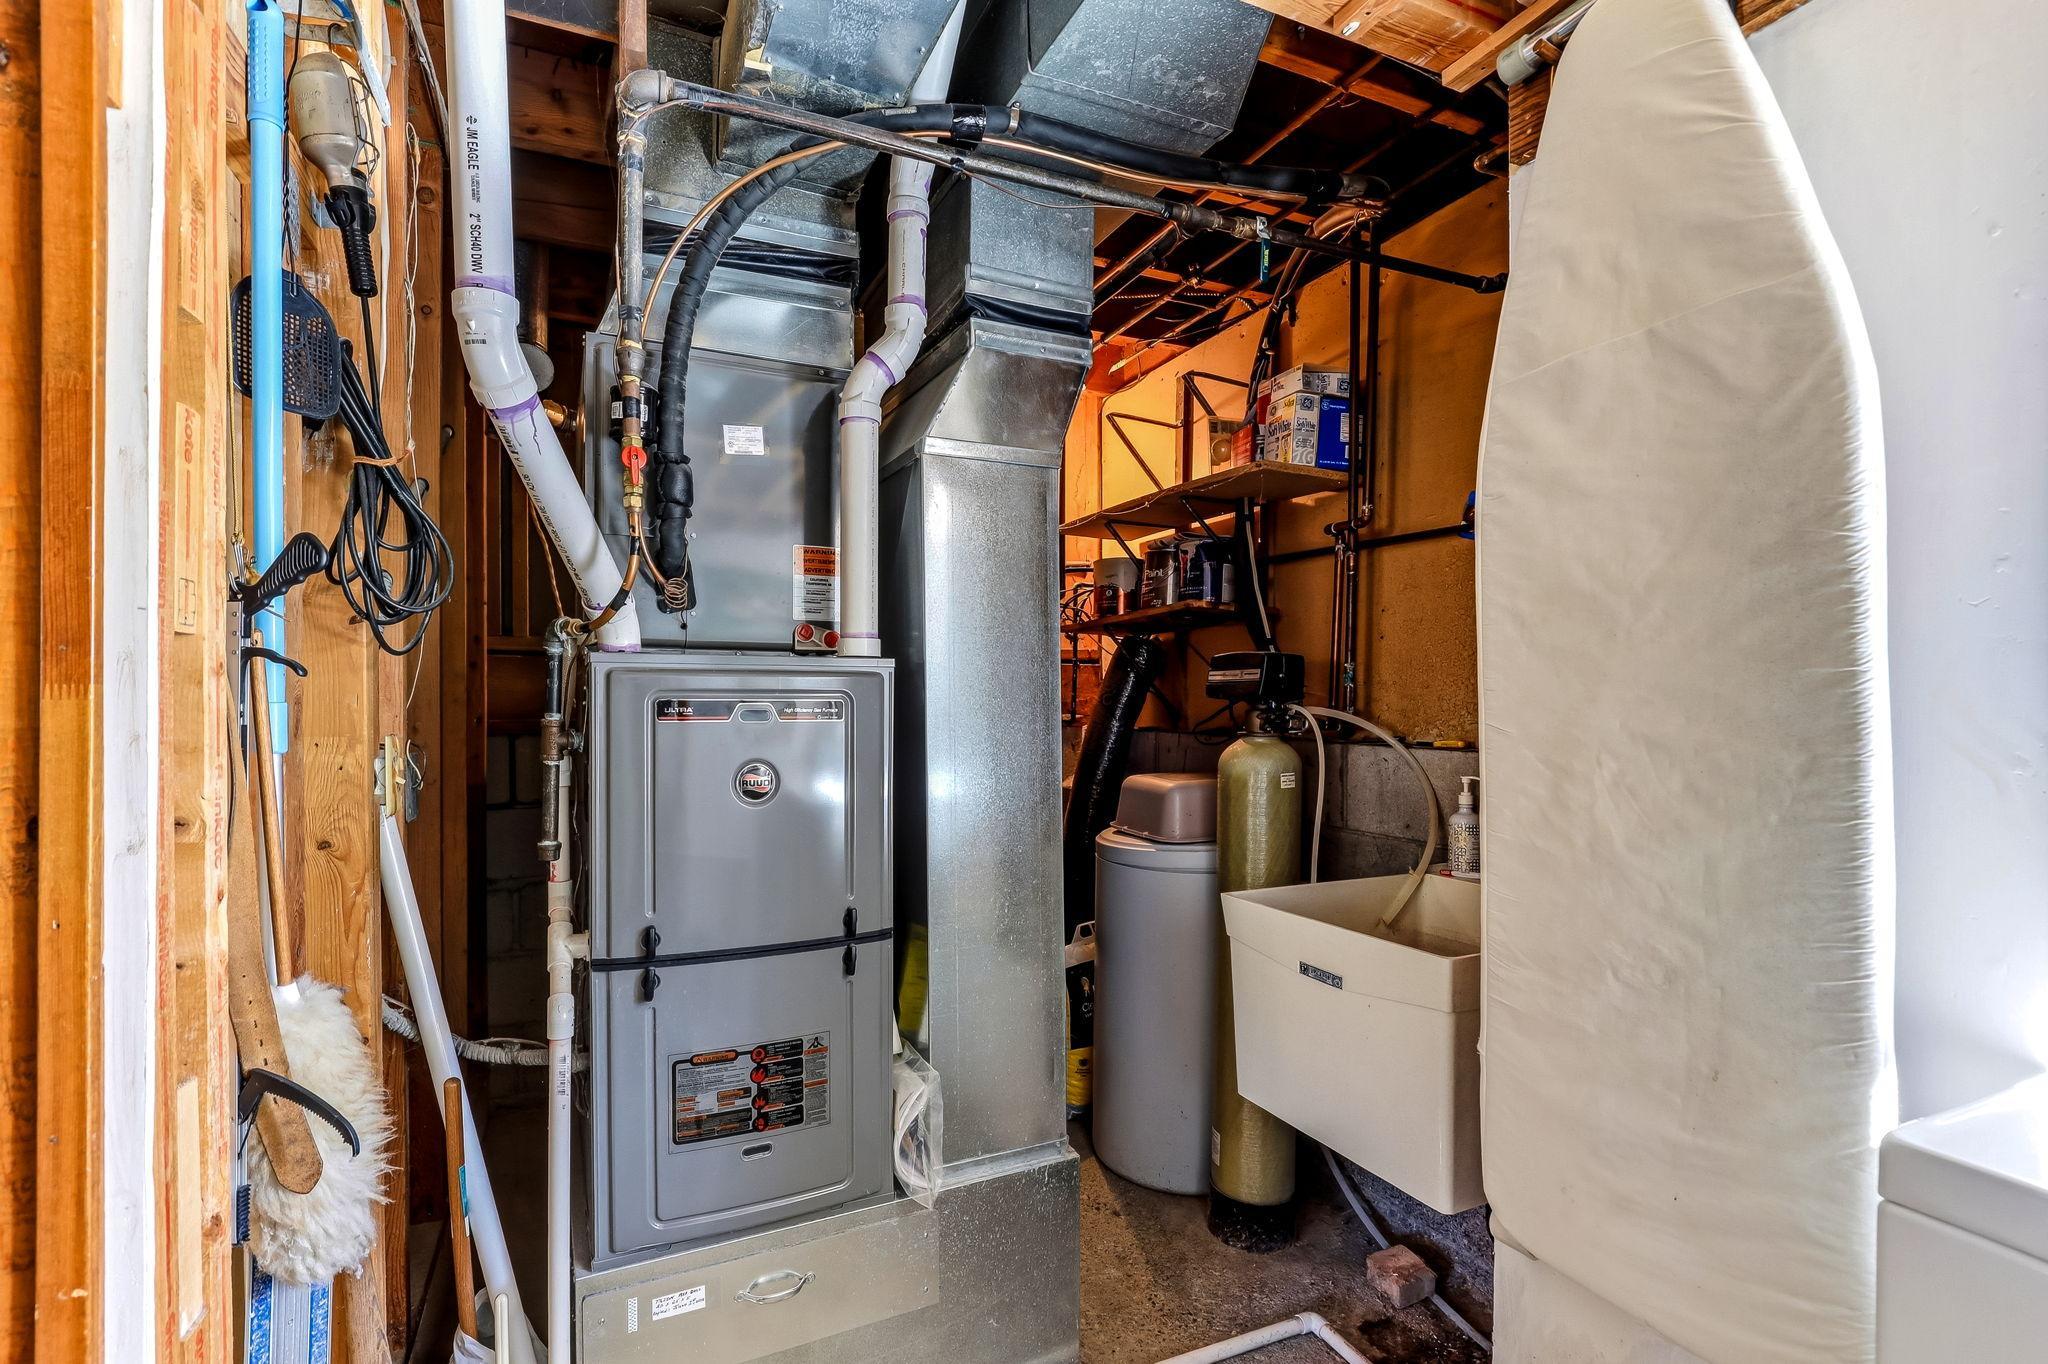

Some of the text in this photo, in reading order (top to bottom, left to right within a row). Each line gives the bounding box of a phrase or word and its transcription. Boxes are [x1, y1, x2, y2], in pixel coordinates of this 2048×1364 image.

[465, 126, 479, 140] JM
[466, 141, 480, 171] EAGLE
[469, 223, 482, 252] SCH40
[471, 252, 483, 274] DWV
[1144, 568, 1164, 578] Paint
[742, 779, 771, 787] RUUD
